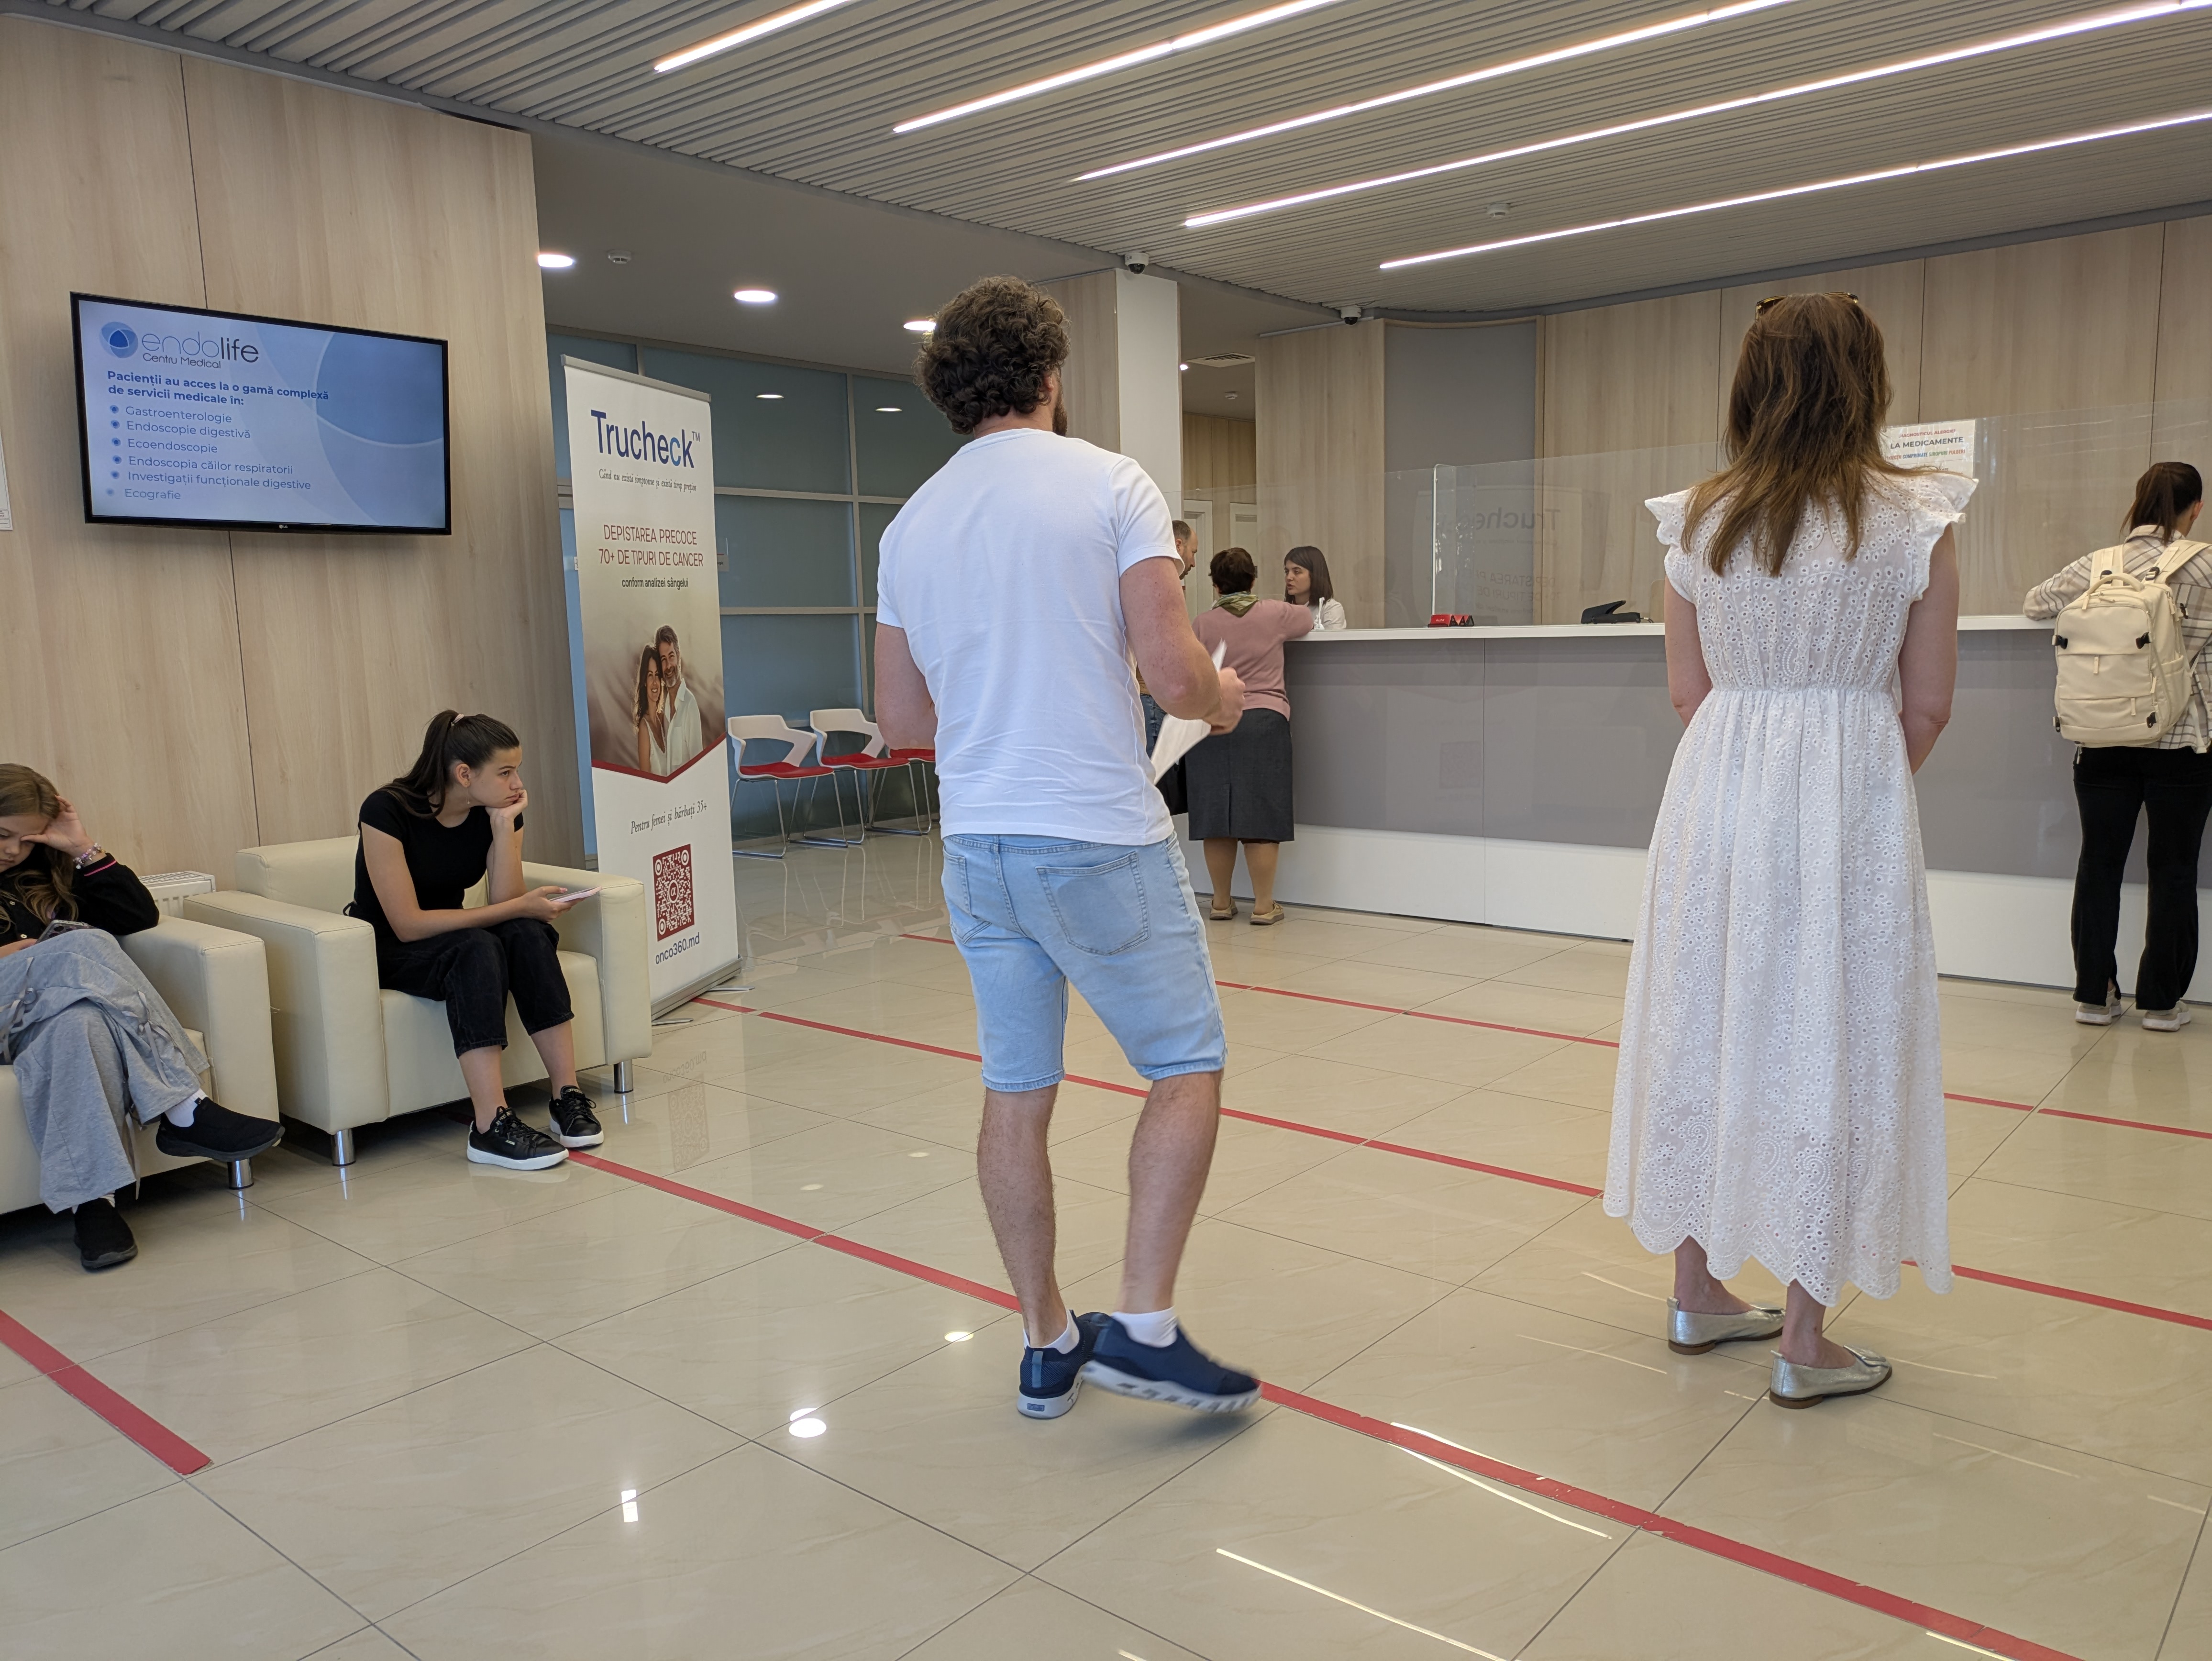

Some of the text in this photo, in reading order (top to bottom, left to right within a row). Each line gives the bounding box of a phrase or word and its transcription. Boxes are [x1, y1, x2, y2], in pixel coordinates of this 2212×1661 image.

[142, 331, 259, 363] endolife
[143, 353, 221, 369] Centru Medical
[108, 370, 162, 386] Pacienții
[165, 378, 179, 386] au
[183, 380, 216, 389] acces
[219, 381, 229, 391] la
[243, 385, 274, 395] gamă
[277, 389, 329, 400] complexă
[108, 385, 244, 405] de servicii medicale în:
[125, 406, 232, 424] Gastroenterologie
[127, 421, 250, 439] Endoscopie digestivă
[128, 438, 218, 454] Ecoendoscopie
[1902, 437, 1963, 448] MEDICAMENTE
[129, 456, 293, 474] Endoscopia căilor respiratorii
[128, 471, 311, 489] Investigații funcționale digestive
[599, 468, 612, 480] Când
[621, 473, 634, 483] există
[635, 474, 654, 487] simptome
[661, 478, 672, 488] există
[674, 480, 682, 492] timp
[125, 488, 181, 500] Ecografie
[603, 524, 697, 545] DEPISTAREA PRECOCE
[598, 548, 704, 567] 70+ DE TIPURI DE CANCER
[621, 576, 688, 590] conform analizei sângelui
[630, 820, 650, 834] Pentru
[651, 811, 665, 831] femei
[674, 803, 695, 819] bărbați
[697, 800, 708, 813] 35+
[655, 931, 700, 965] onco360.md
